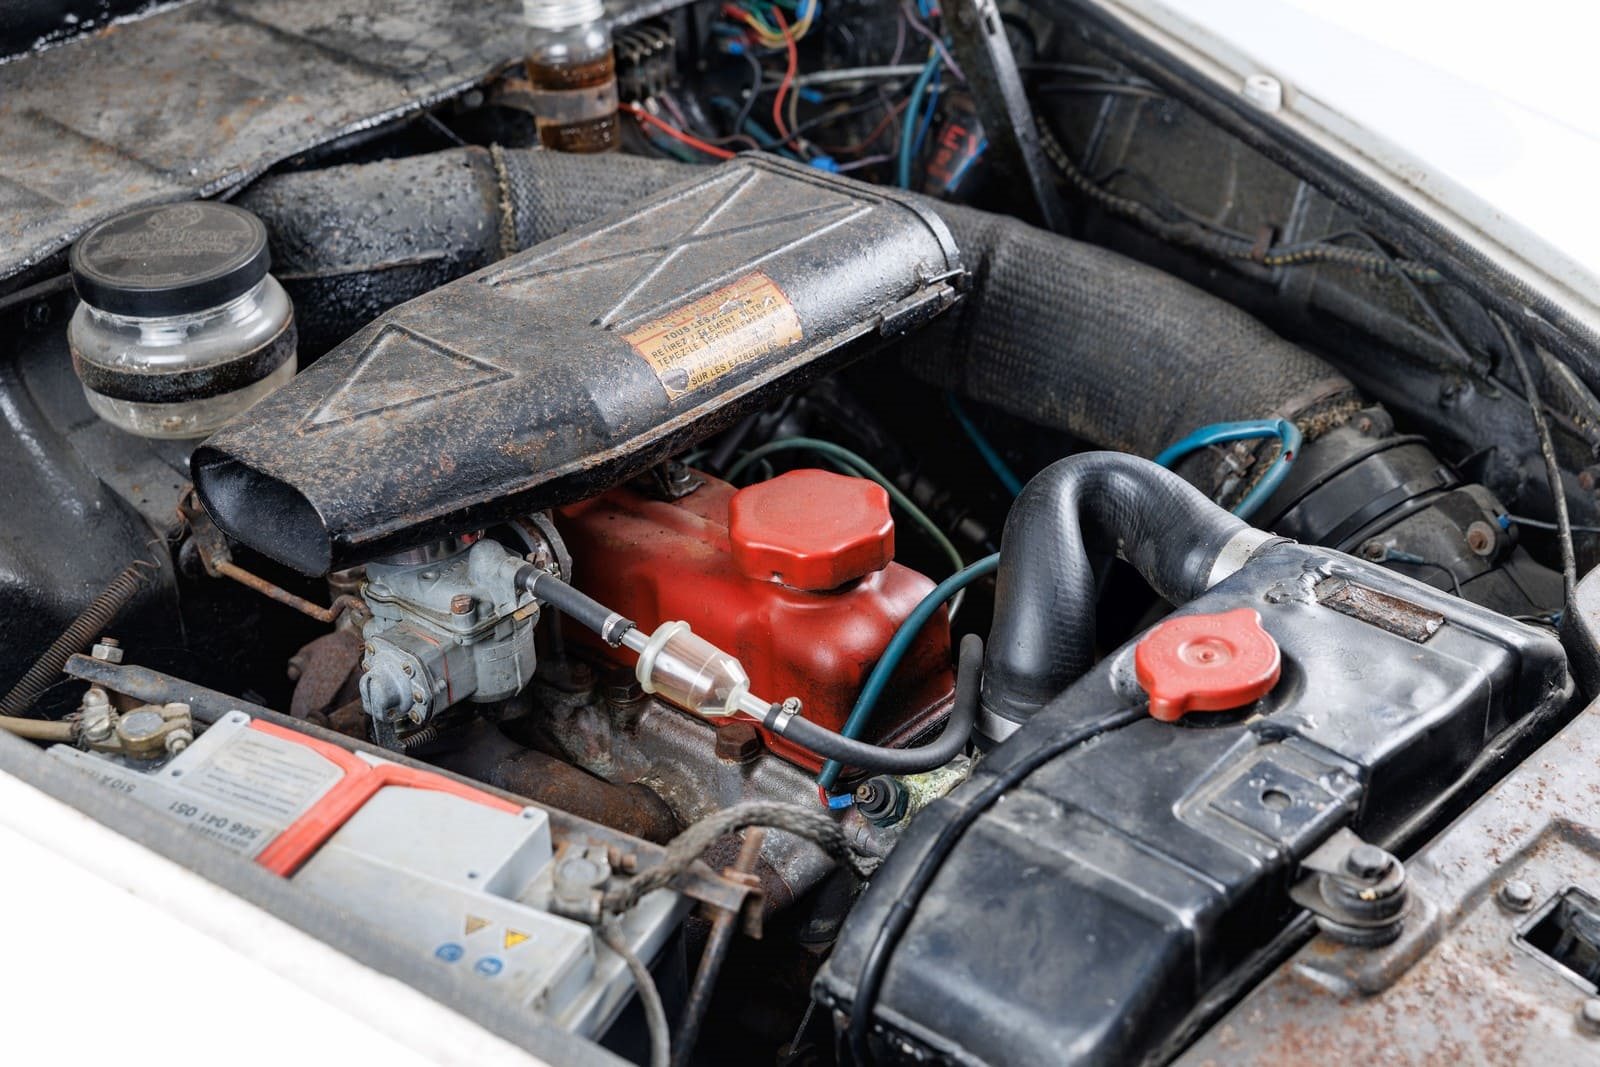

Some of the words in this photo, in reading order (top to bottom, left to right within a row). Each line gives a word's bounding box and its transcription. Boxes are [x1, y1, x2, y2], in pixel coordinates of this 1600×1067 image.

[663, 326, 690, 341] TOUS
[651, 337, 688, 359] RETIREZ
[691, 371, 709, 386] SUR
[710, 365, 727, 376] LES
[168, 801, 198, 817] 051
[200, 812, 229, 829] 041
[229, 822, 261, 840] 566
